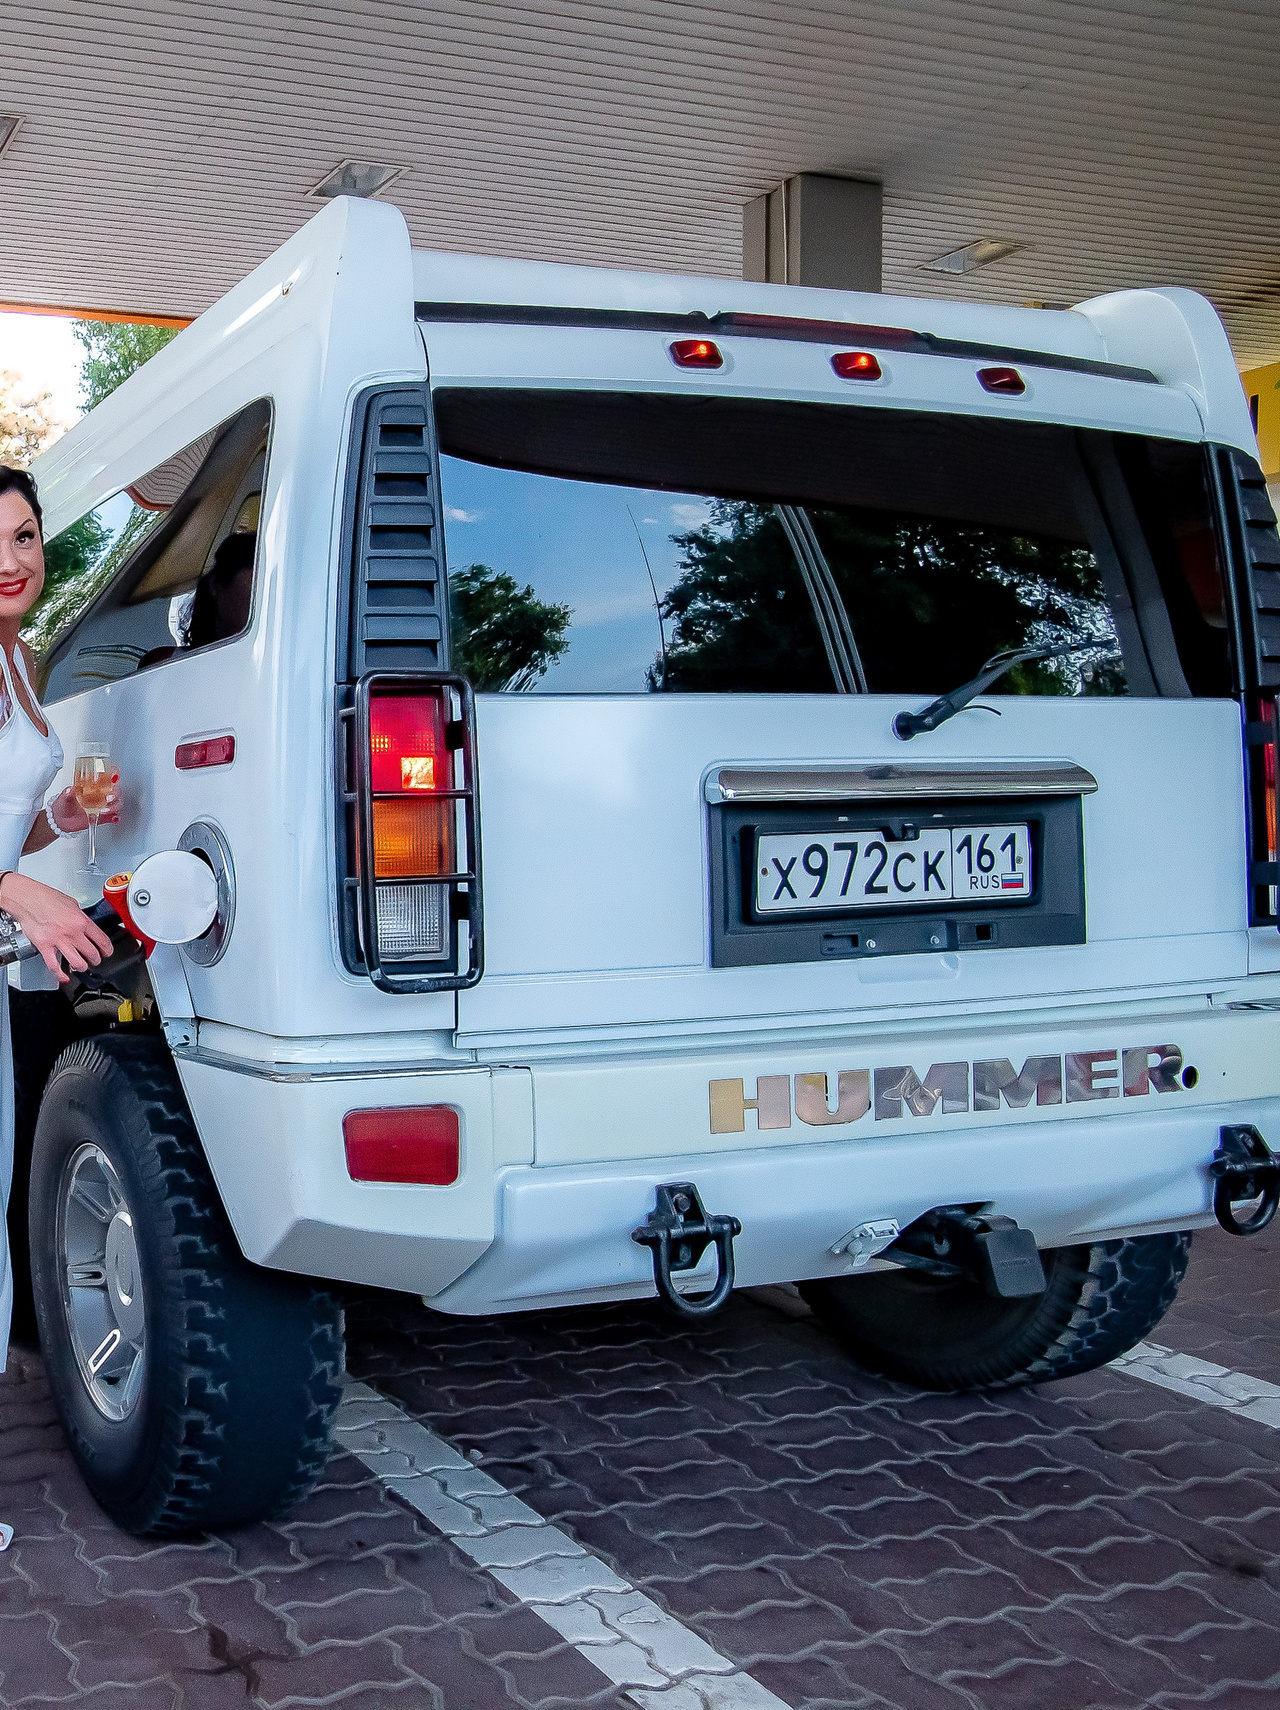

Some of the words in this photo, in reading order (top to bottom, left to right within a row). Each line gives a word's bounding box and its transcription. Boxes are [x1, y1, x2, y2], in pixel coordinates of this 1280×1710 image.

[955, 832, 1018, 875] 161
[969, 874, 1000, 890] RUS
[708, 1043, 1185, 1134] HUMMER
